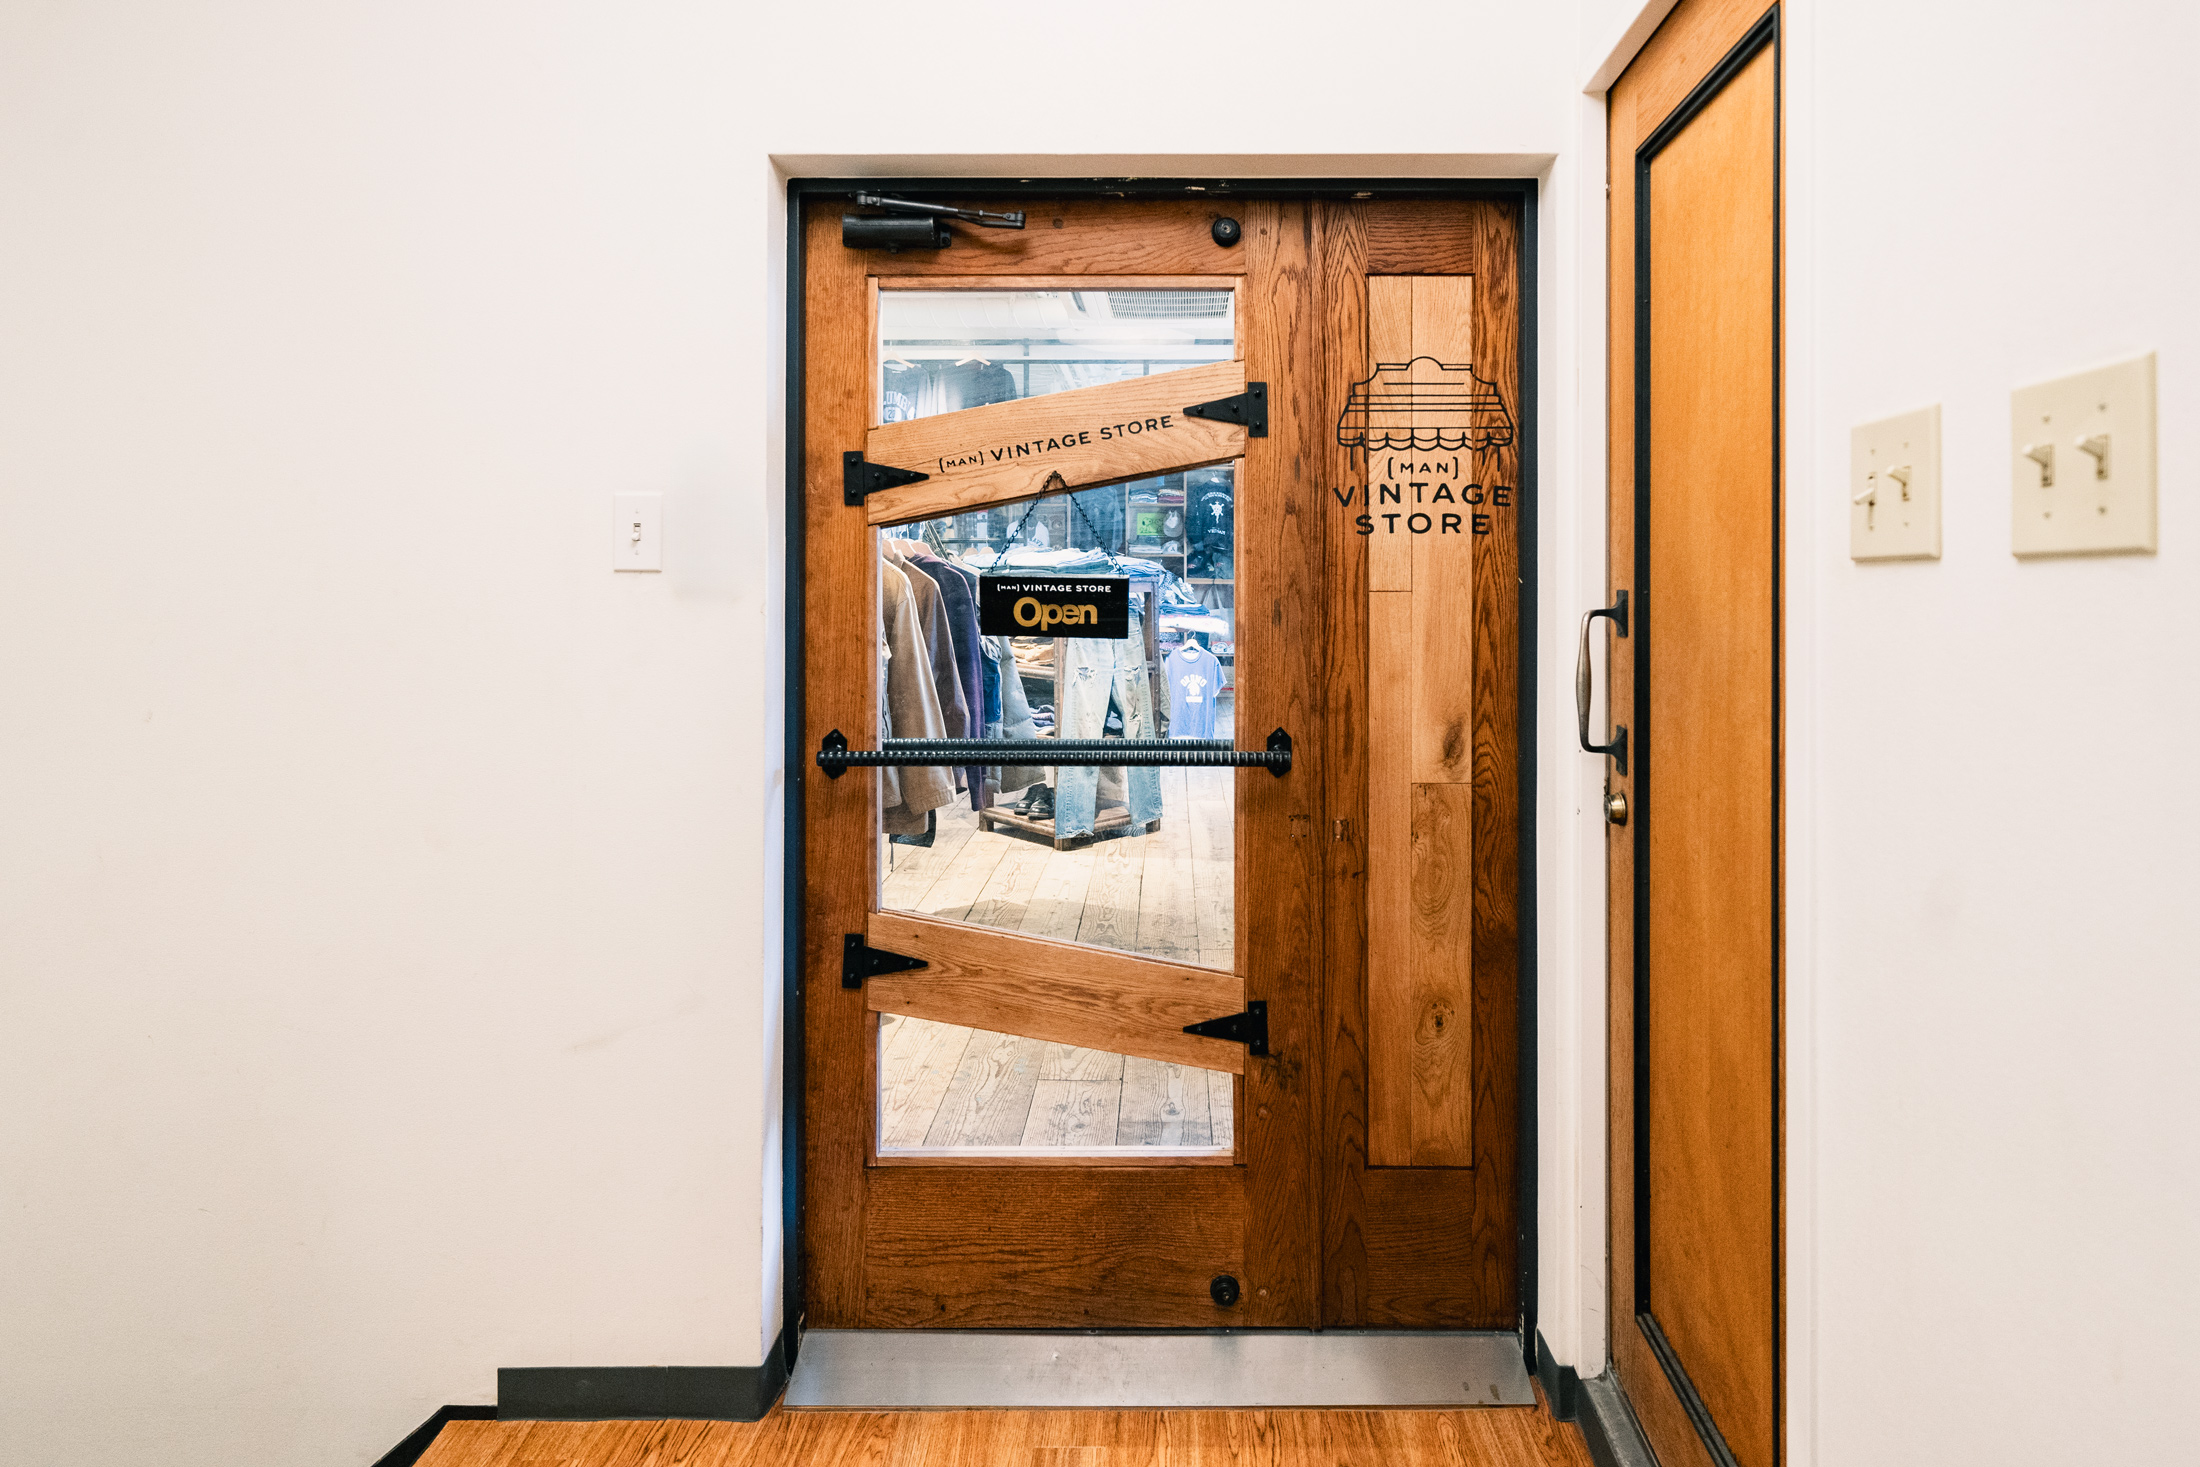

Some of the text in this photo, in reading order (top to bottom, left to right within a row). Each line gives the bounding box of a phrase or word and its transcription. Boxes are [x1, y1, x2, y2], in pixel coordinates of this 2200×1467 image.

[990, 431, 1092, 461] VINTAGE
[1100, 415, 1174, 440] STORE
[1333, 482, 1512, 508] VINTAGE
[1355, 512, 1491, 536] STORE
[1023, 584, 1072, 592] VINTAGE
[1075, 585, 1111, 593] STORE
[1013, 596, 1098, 631] Open
